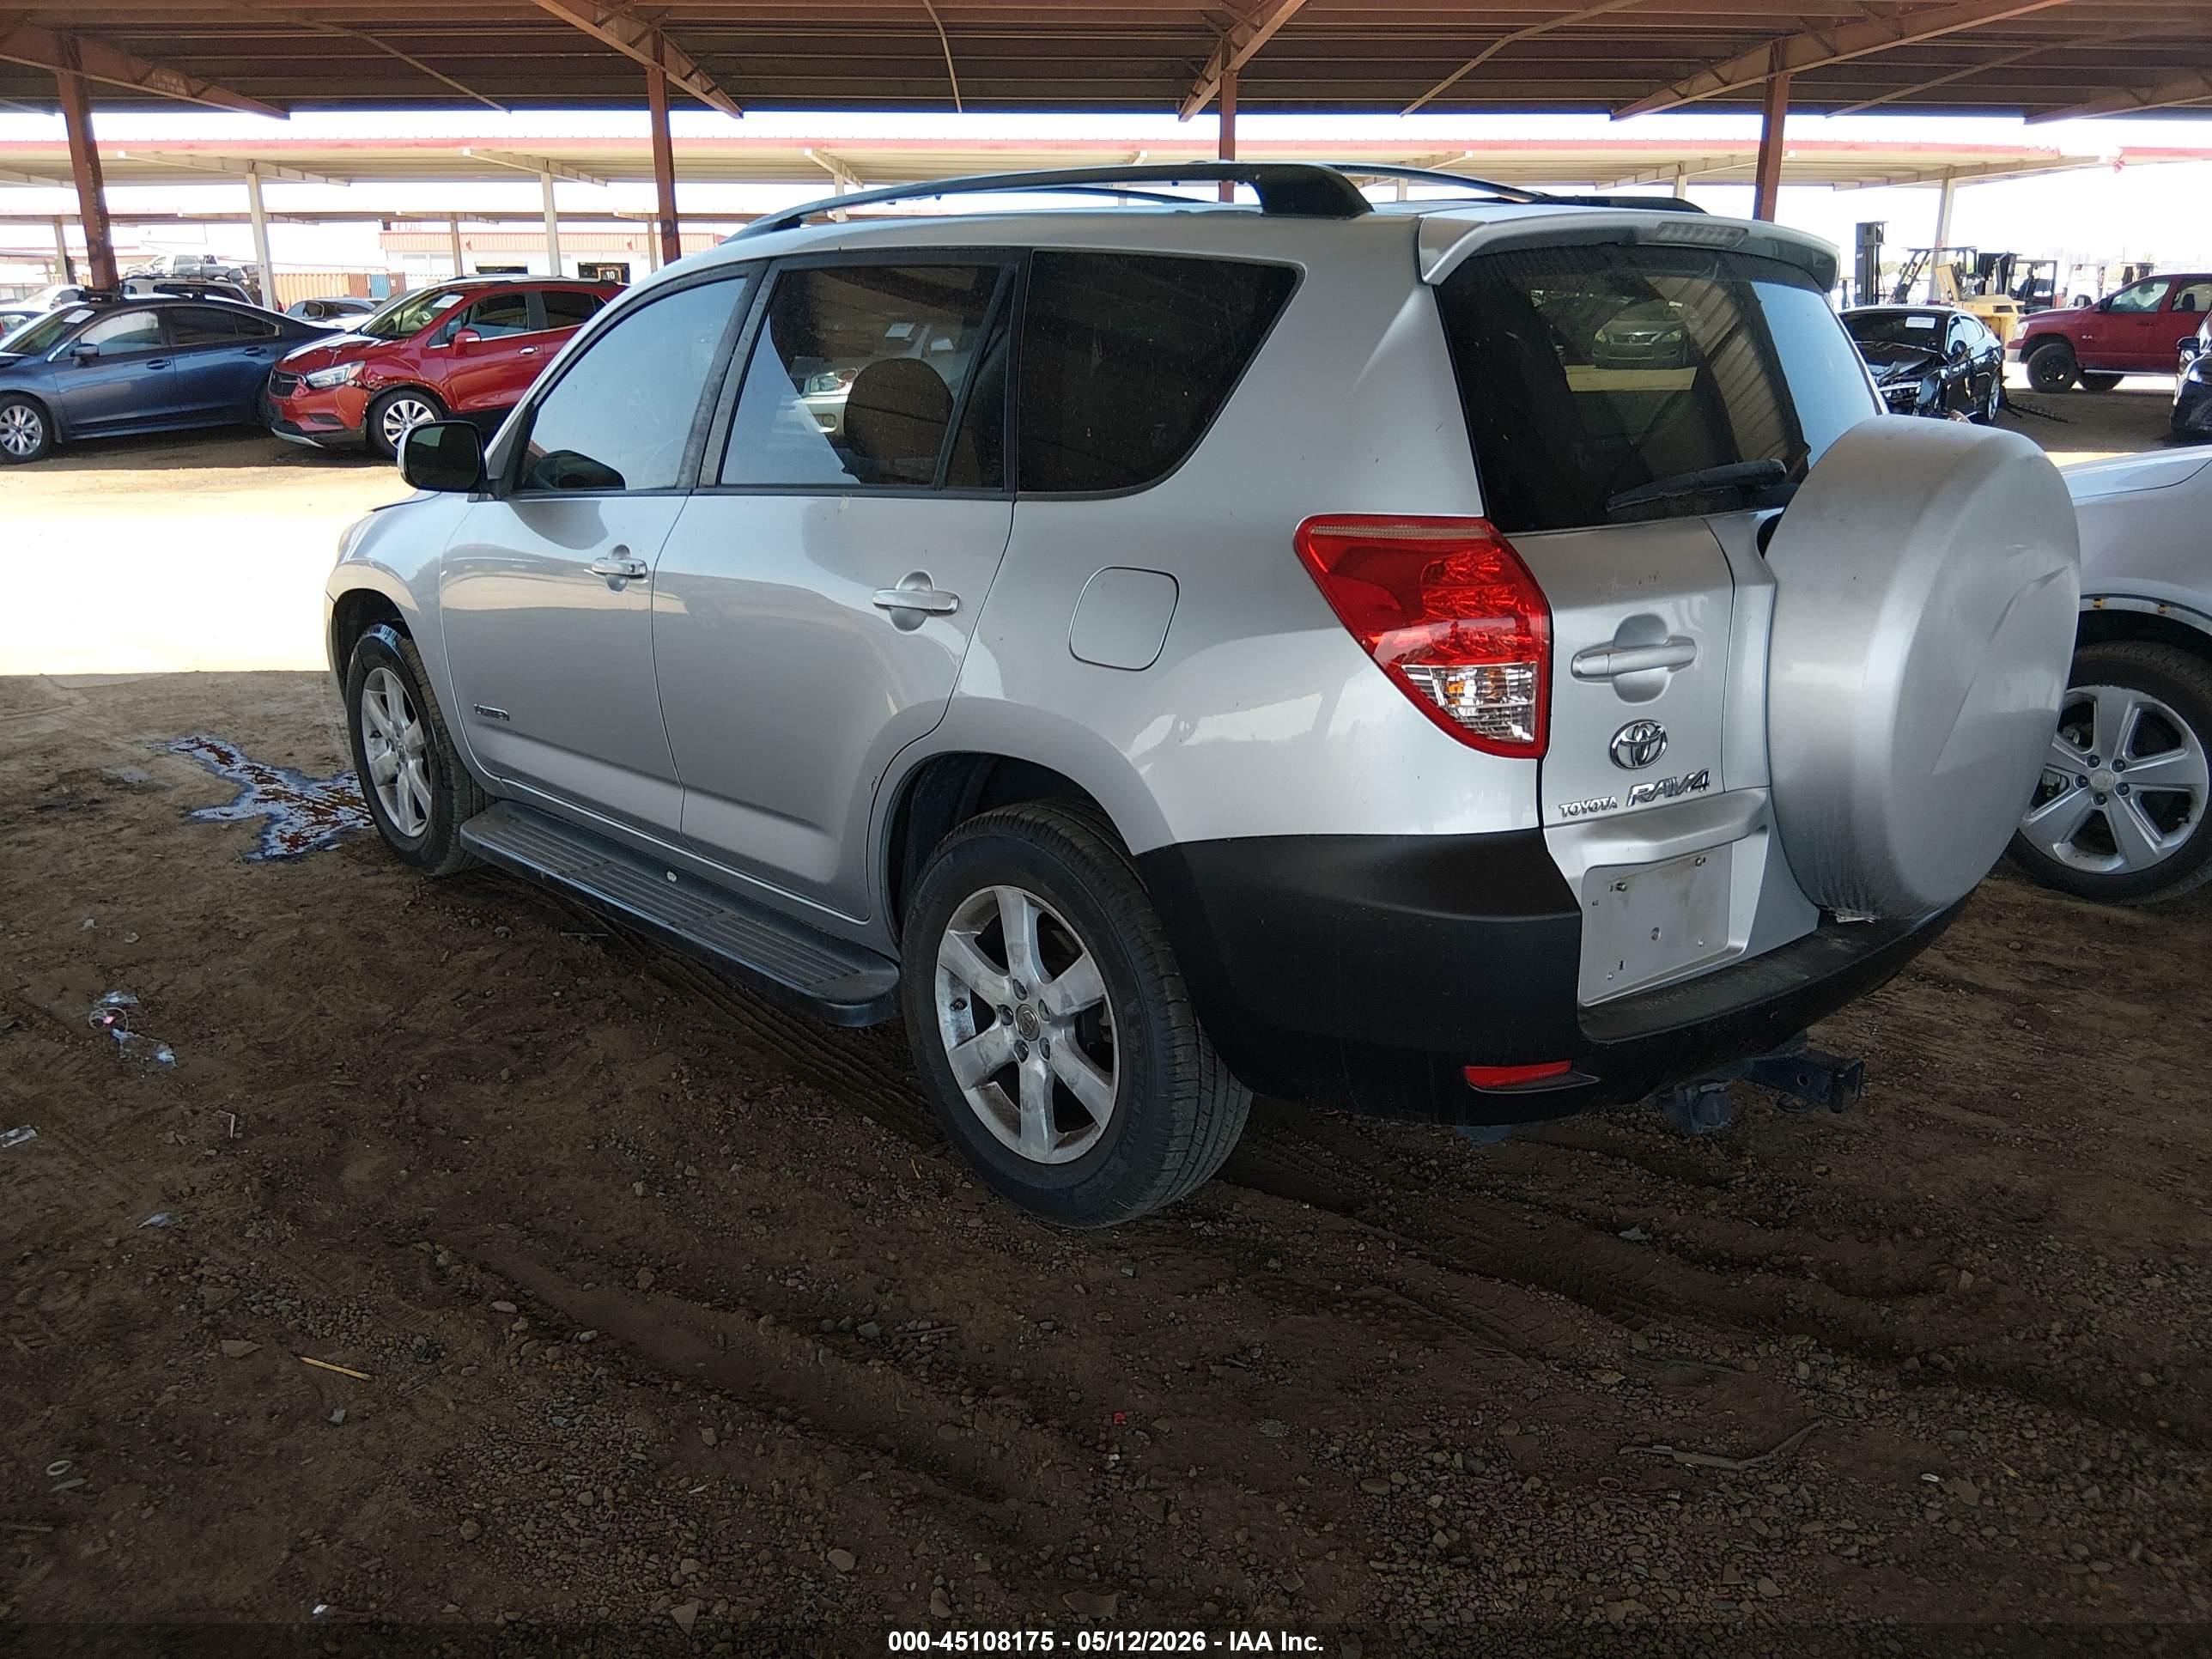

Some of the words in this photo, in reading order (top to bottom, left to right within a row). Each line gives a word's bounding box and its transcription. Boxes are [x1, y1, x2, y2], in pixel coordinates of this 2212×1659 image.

[605, 270, 616, 280] 10
[1559, 796, 1618, 817] TOYOTA
[1627, 769, 1711, 806] RAV4
